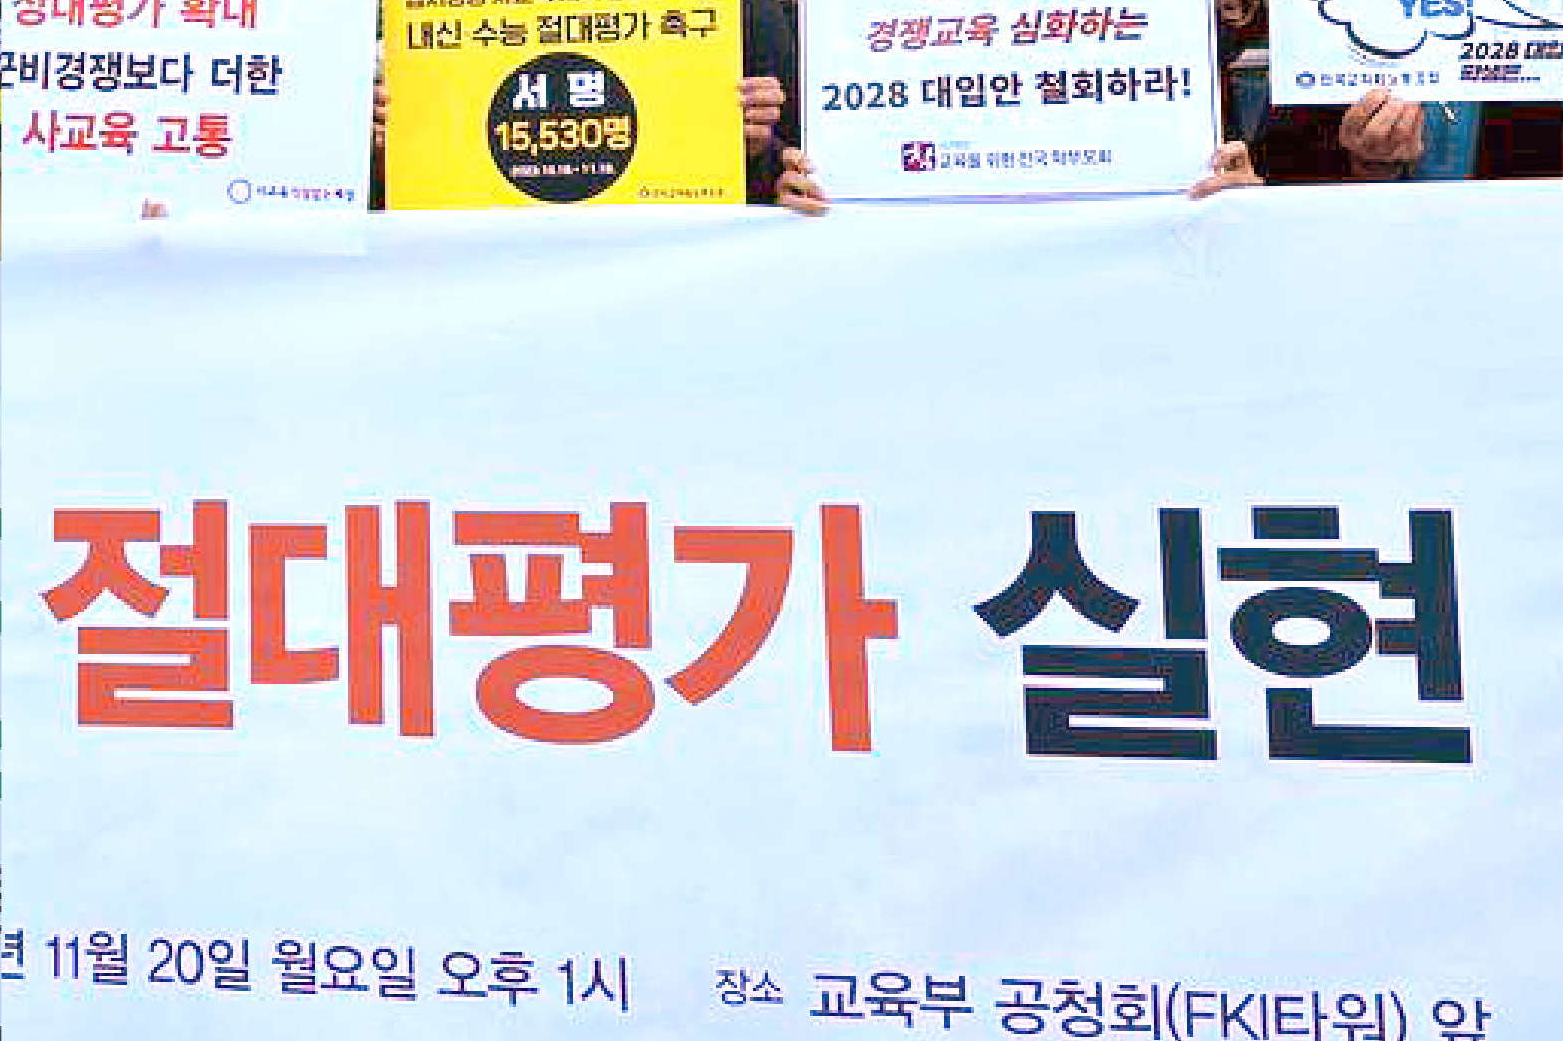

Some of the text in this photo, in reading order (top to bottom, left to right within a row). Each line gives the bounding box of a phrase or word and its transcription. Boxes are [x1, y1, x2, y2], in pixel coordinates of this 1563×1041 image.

[407, 8, 717, 49] 내신 수능 절대평가 촉구
[867, 7, 1148, 52] 경쟁교육 심화하는
[1459, 41, 1520, 60] 2028
[211, 53, 282, 95] 더한
[822, 66, 1191, 110] 2028 대입안 철회하라!
[23, 110, 138, 155] 사교육
[151, 113, 232, 159] 고통
[496, 115, 632, 156] 15,530명
[41, 498, 1473, 763] 절대평가 실현
[45, 931, 127, 986] 11월
[147, 938, 251, 992] 20일
[272, 939, 417, 1001] 월요일
[438, 950, 538, 1006] 오후
[558, 956, 629, 1012] 1시
[715, 968, 783, 1007] 장소
[810, 971, 974, 1029] 교육부
[995, 977, 1407, 1041] 공청회(FKI타워)
